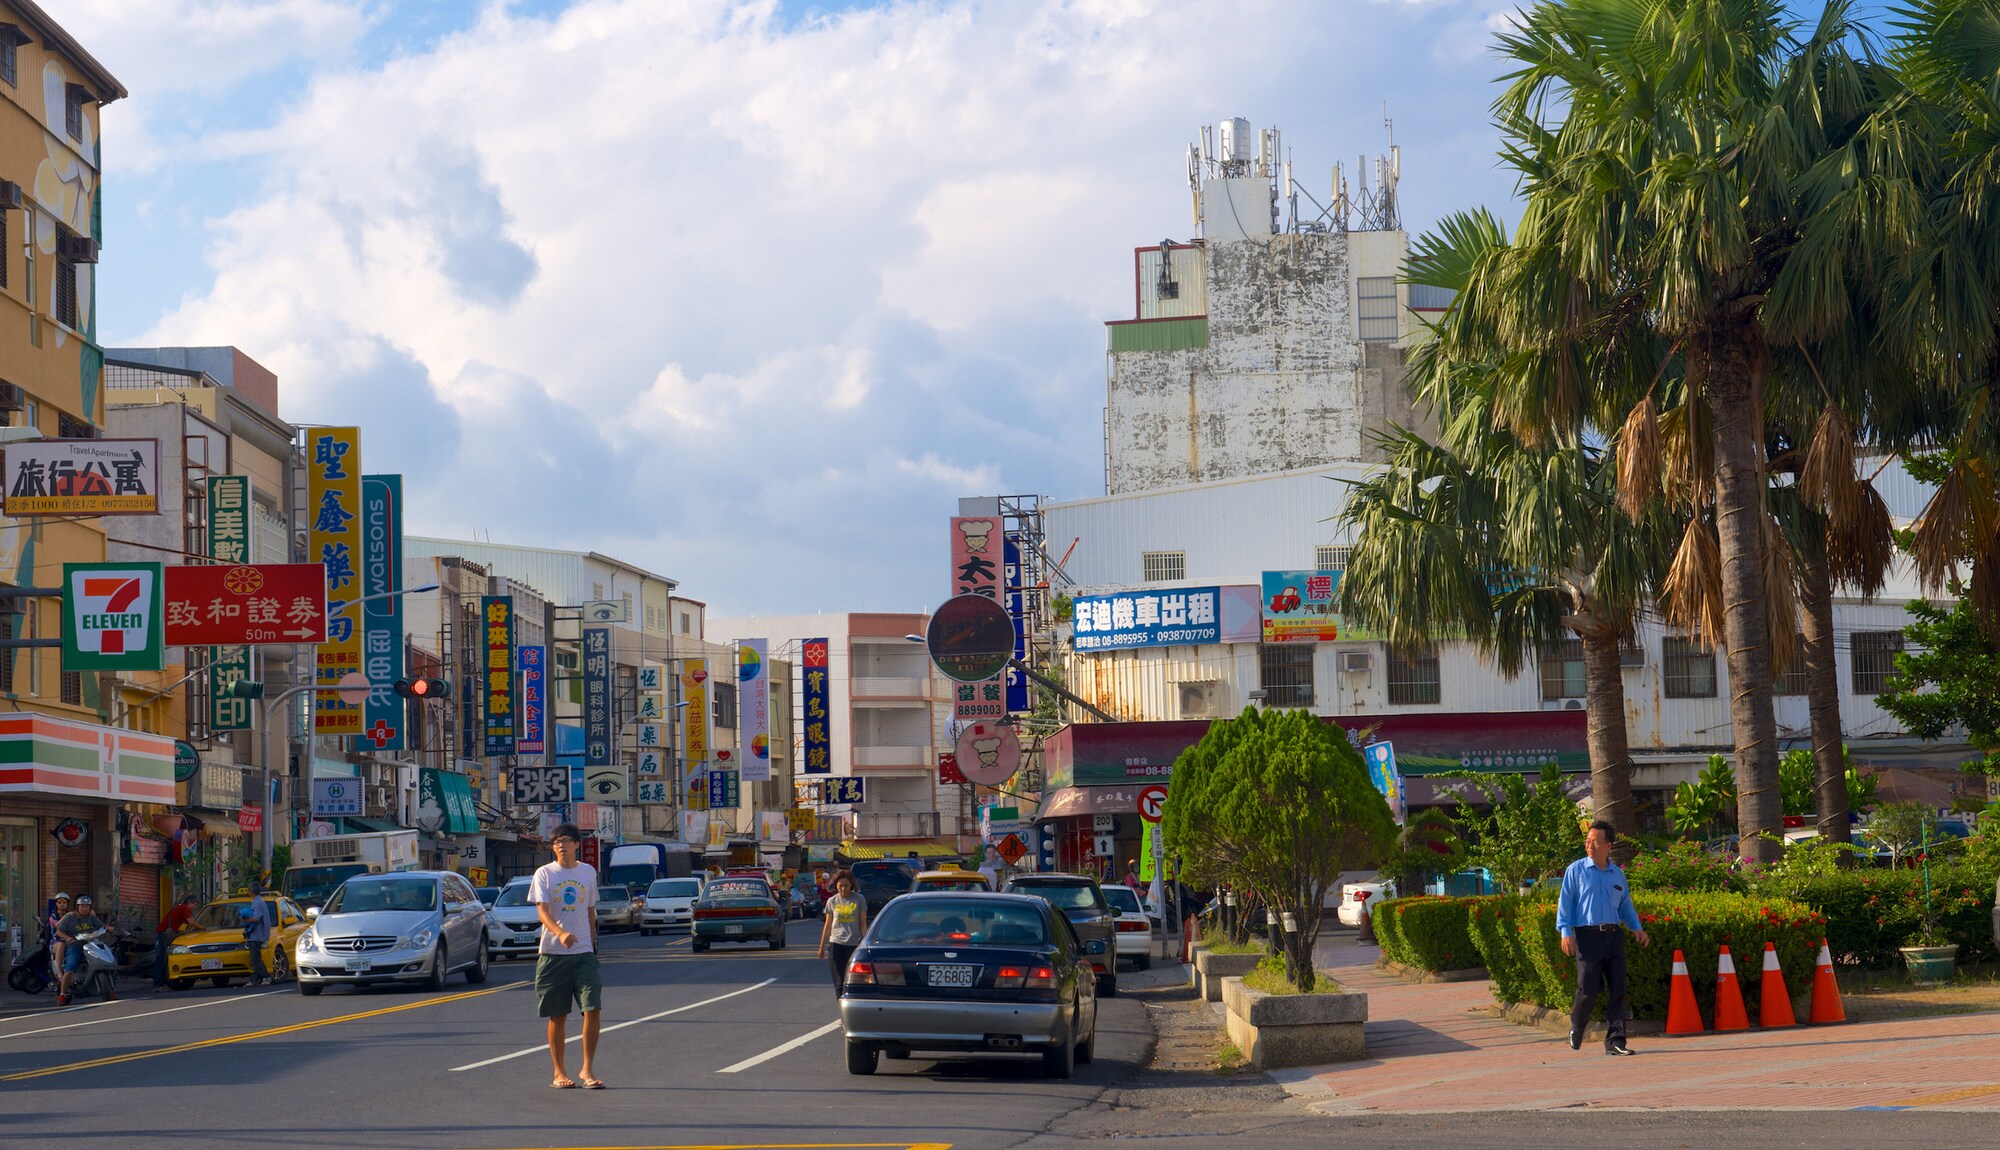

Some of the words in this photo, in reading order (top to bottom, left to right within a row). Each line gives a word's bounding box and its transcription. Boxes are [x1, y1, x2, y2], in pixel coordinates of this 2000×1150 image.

[69, 444, 90, 455] Travel
[92, 448, 128, 458] Apartment
[10, 458, 147, 497] 旅行公寓
[102, 500, 154, 508] 0977332150
[313, 435, 356, 643] 聖鑫藥局
[368, 499, 386, 598] watsons
[167, 596, 320, 626] 致和證券
[1076, 592, 1215, 632] 宏迪機車出租
[246, 629, 276, 640] 50m
[1102, 632, 1148, 646] 08-8895955
[1158, 628, 1215, 642] 0938707709
[487, 604, 510, 714] 好來屋餐飲
[689, 696, 702, 752] 公益彩券
[807, 670, 828, 769] 寶島眼鏡
[958, 704, 1001, 715] 8899003
[518, 768, 566, 802] 粥
[827, 779, 862, 802] 寶島
[1096, 817, 1110, 825] 200
